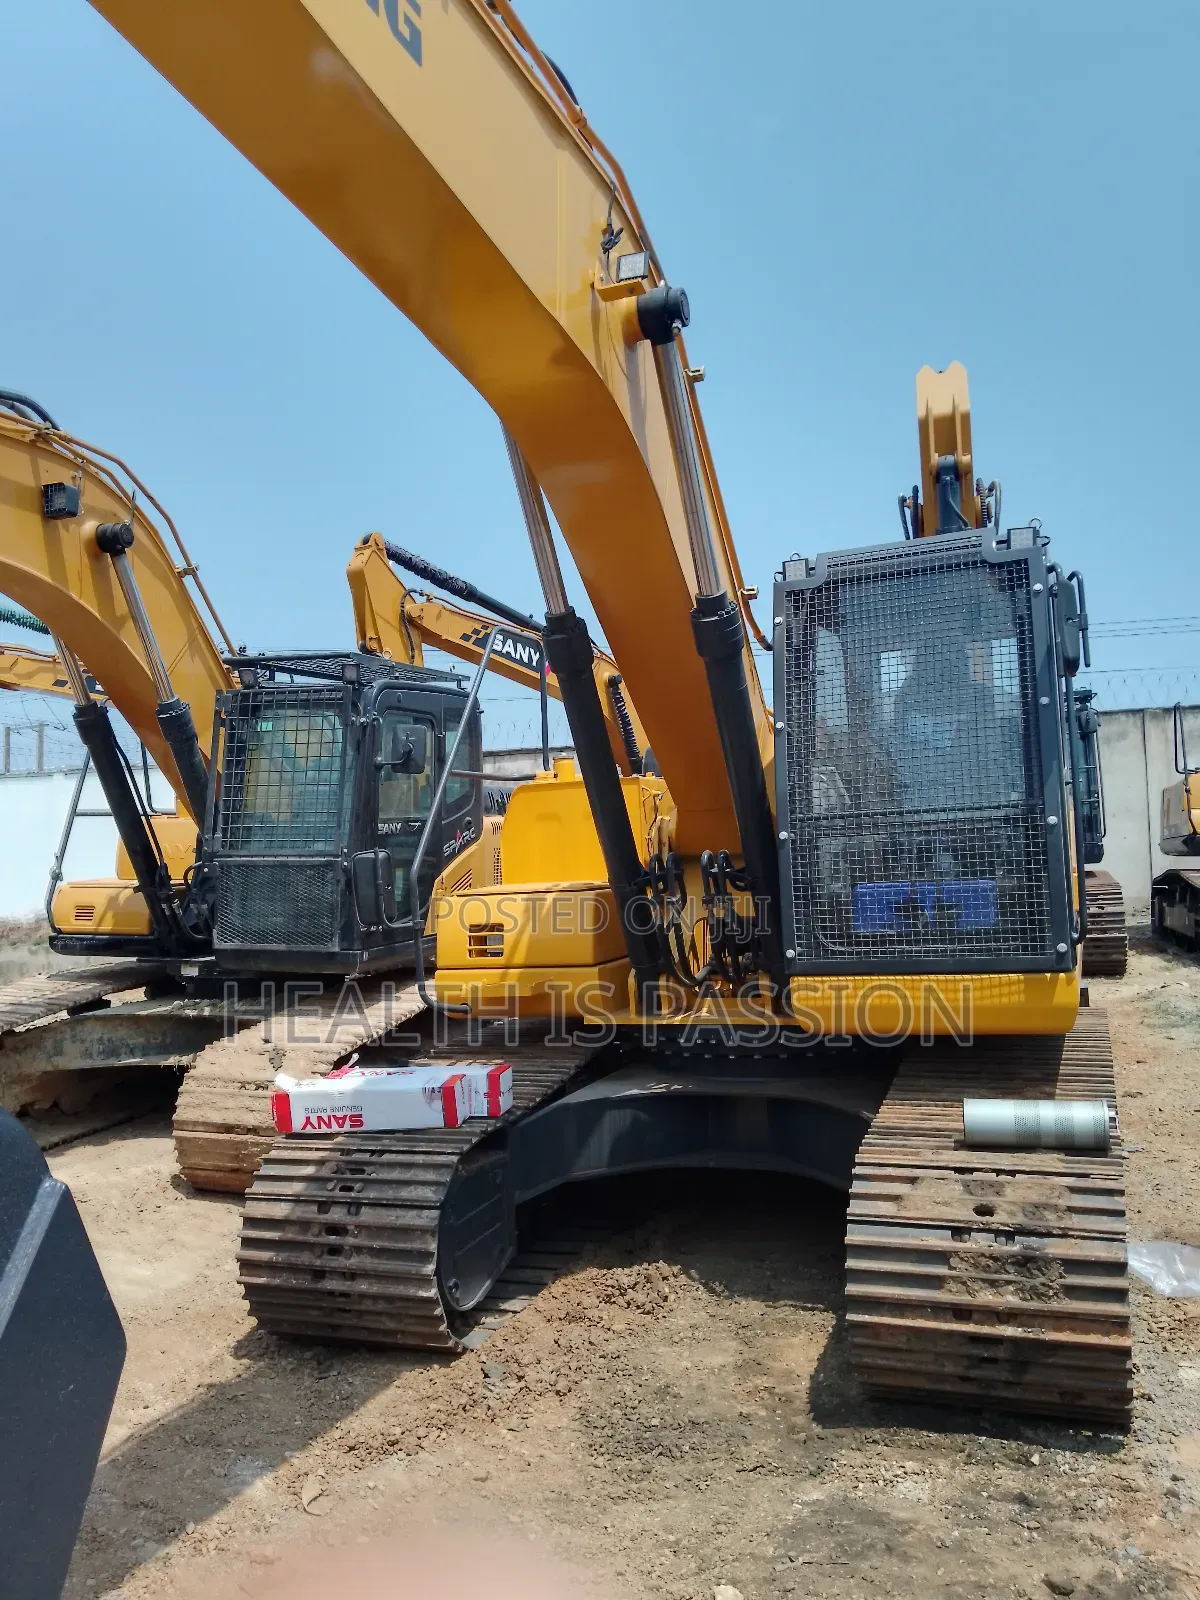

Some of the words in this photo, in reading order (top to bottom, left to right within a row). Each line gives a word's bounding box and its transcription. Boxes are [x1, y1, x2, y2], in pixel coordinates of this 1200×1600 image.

[492, 633, 540, 667] SANY
[377, 822, 402, 834] SANY
[304, 1106, 328, 1114] PARTS
[329, 1105, 363, 1113] GENUINE
[301, 1113, 364, 1131] SANY
